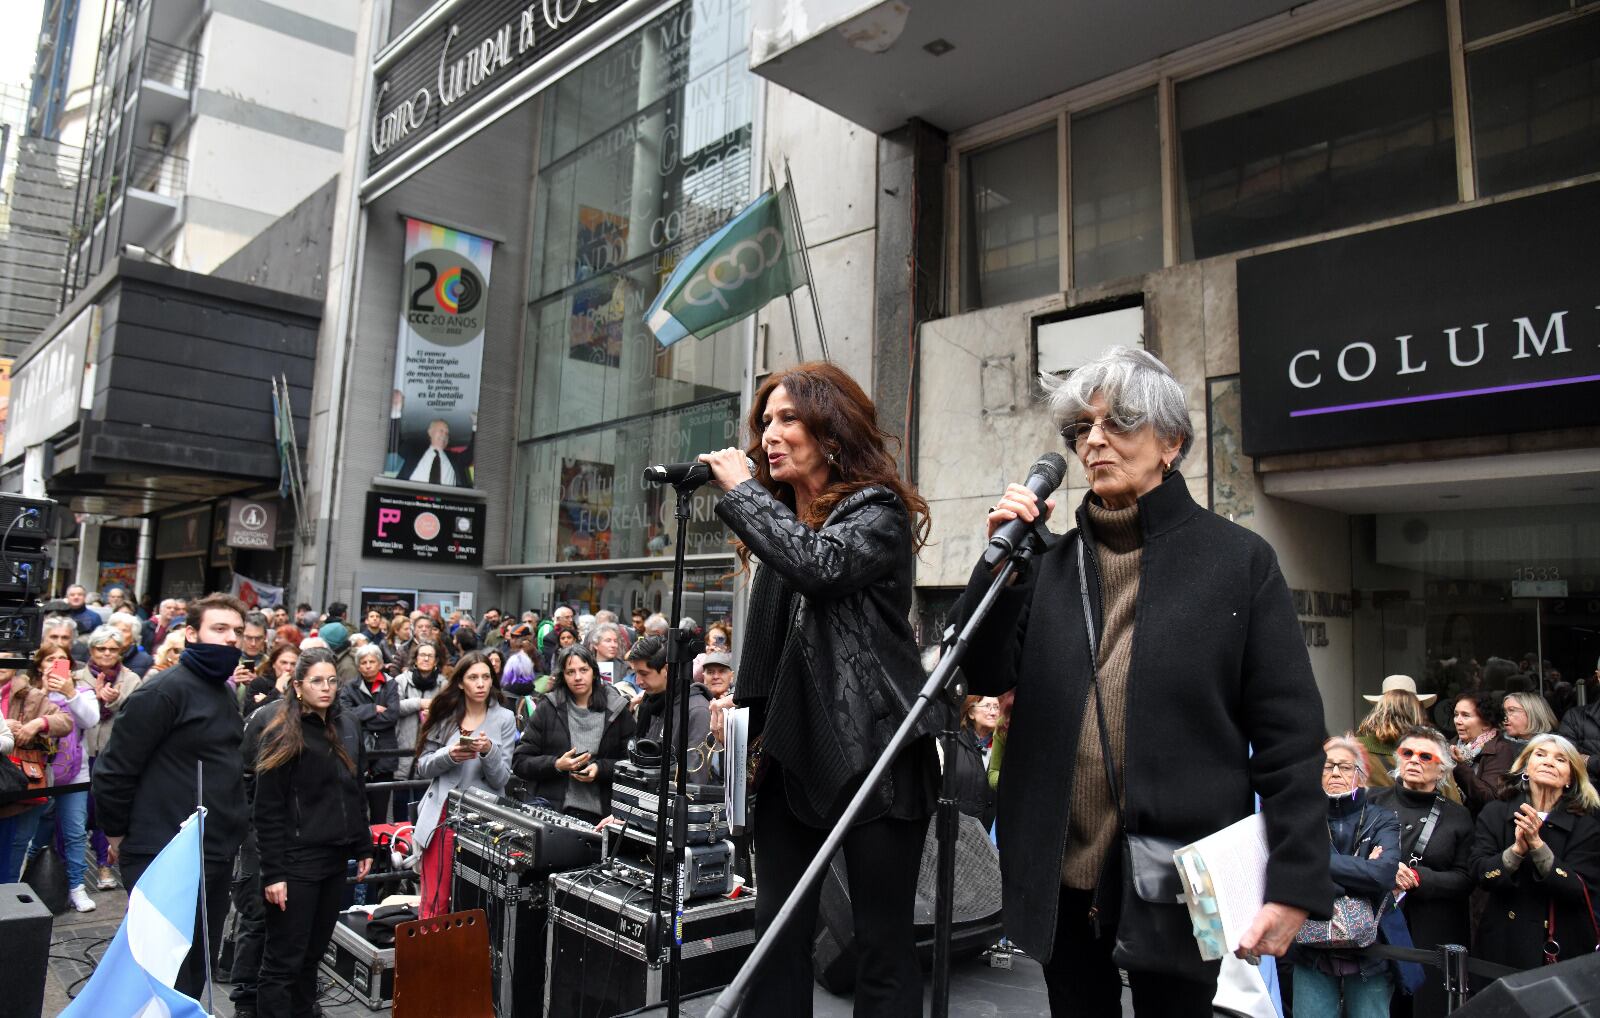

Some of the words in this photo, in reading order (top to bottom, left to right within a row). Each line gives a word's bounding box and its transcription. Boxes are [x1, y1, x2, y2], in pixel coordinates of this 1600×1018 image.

[411, 261, 482, 315] 20
[1288, 304, 1600, 389] COLUM
[232, 535, 268, 546] LOSADA
[1514, 566, 1560, 582] 1533
[677, 862, 685, 912] SAMSON
